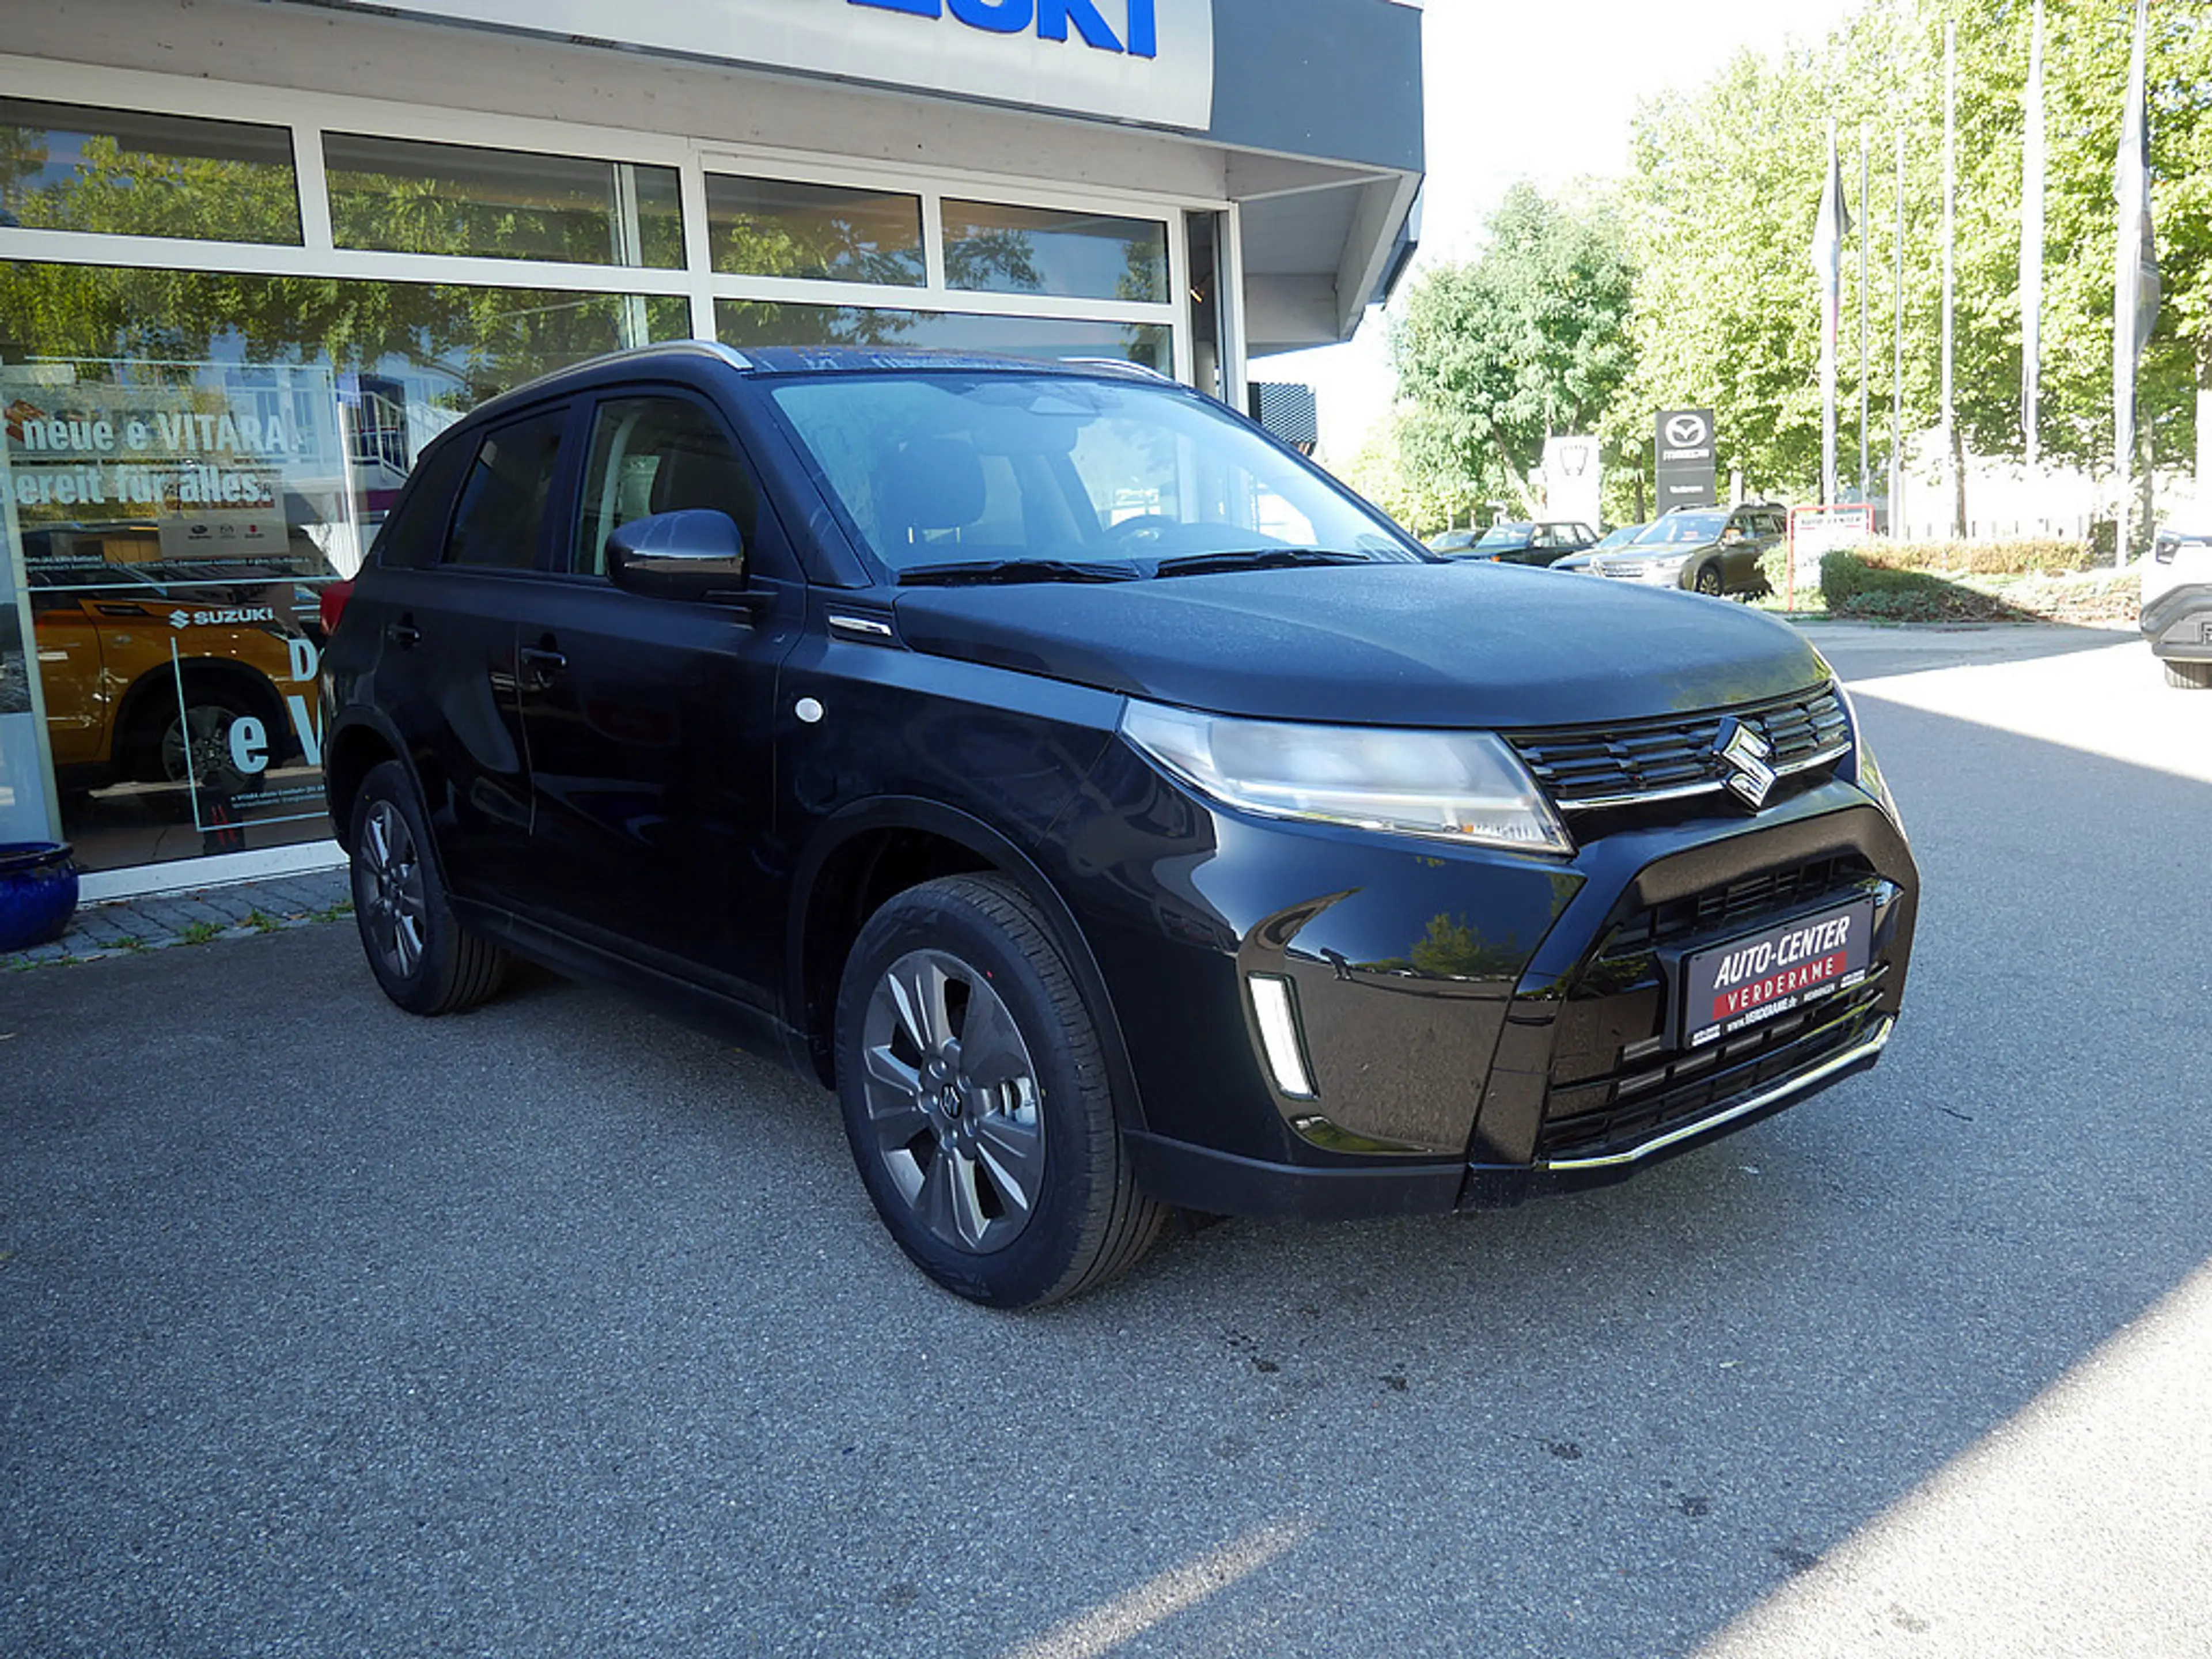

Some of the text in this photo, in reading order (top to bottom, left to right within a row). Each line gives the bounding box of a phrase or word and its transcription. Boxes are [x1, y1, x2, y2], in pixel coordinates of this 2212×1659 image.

[22, 420, 114, 450] neue
[126, 421, 147, 450] e
[116, 463, 169, 504] für
[179, 463, 272, 502] alles.
[194, 607, 275, 626] SUZUKI
[1713, 916, 1850, 989] AUTO-CENTER
[1728, 957, 1834, 1012] VERDERAME
